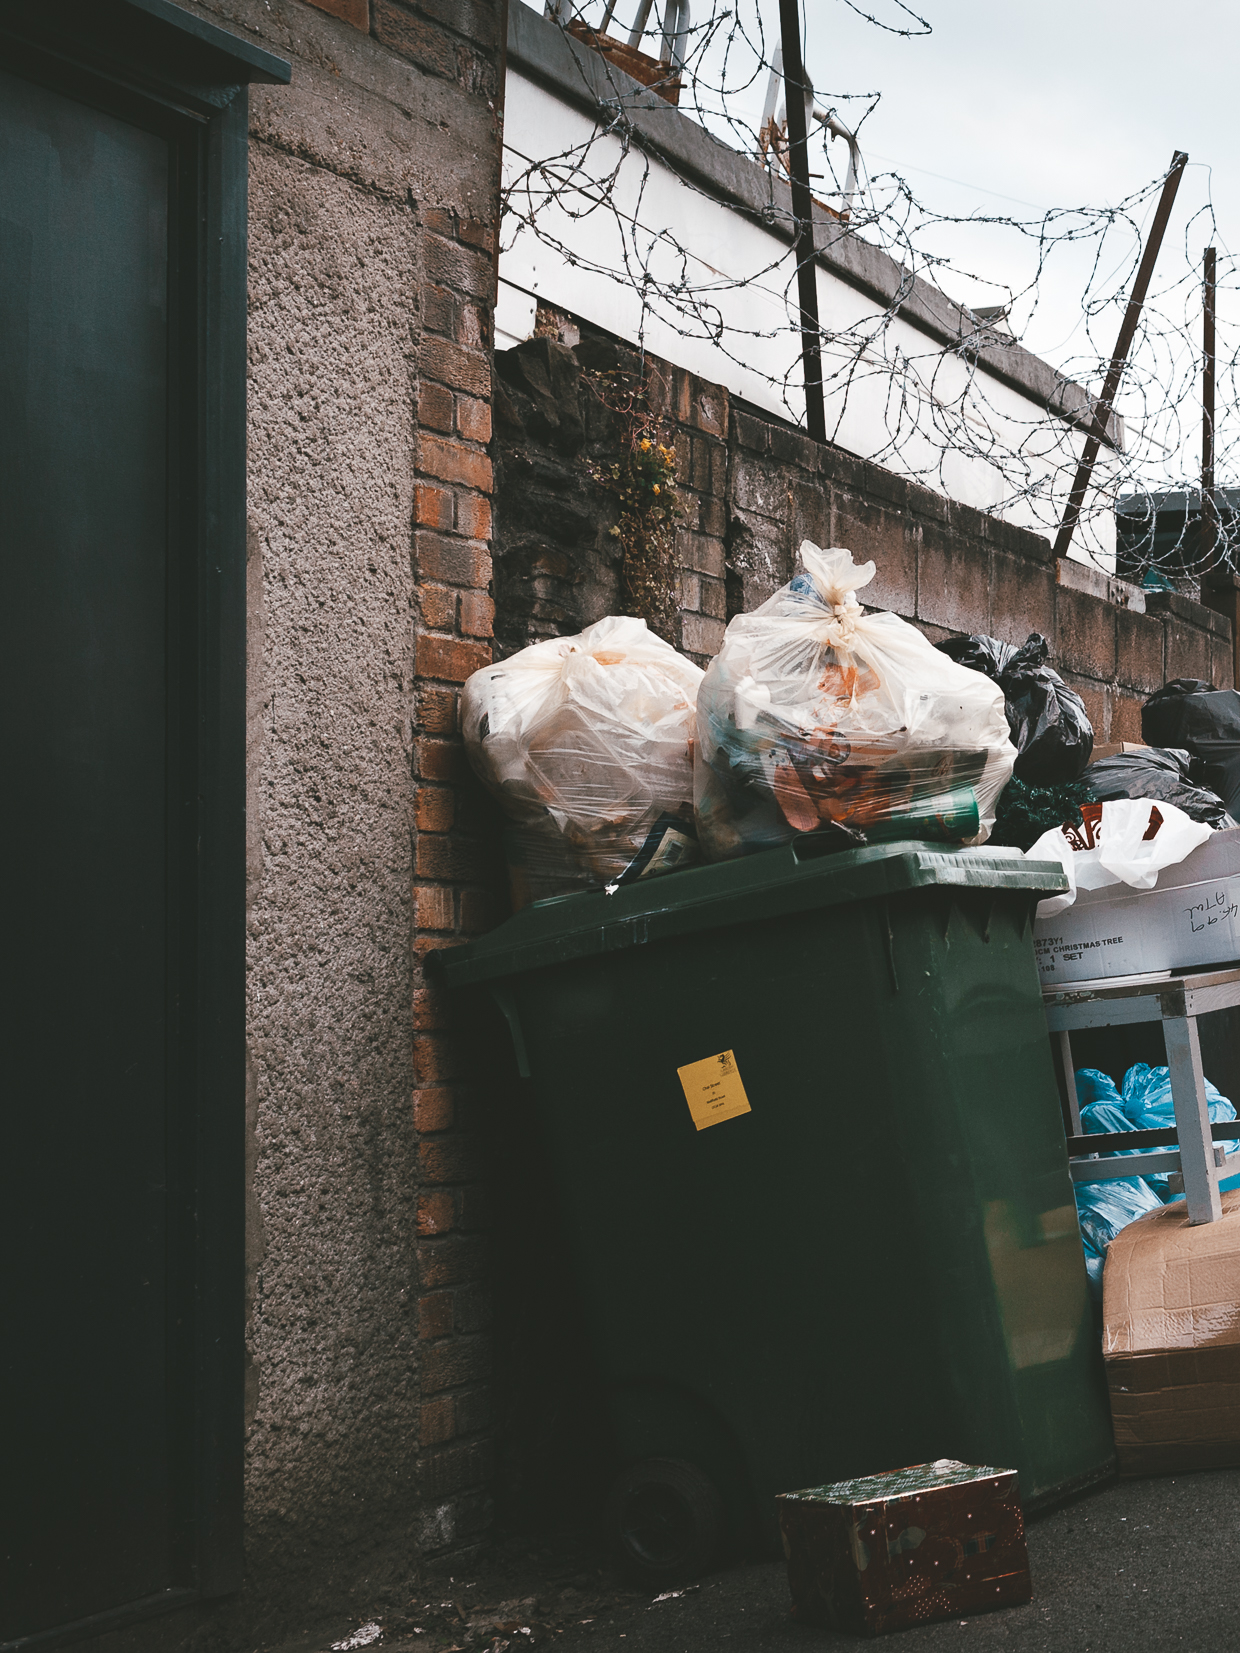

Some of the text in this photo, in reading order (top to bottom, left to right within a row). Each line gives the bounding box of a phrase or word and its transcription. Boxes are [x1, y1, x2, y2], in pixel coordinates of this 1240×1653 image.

[1053, 941, 1101, 954] CHRISTMAS
[1101, 936, 1124, 946] TREE
[1062, 951, 1084, 961] SET
